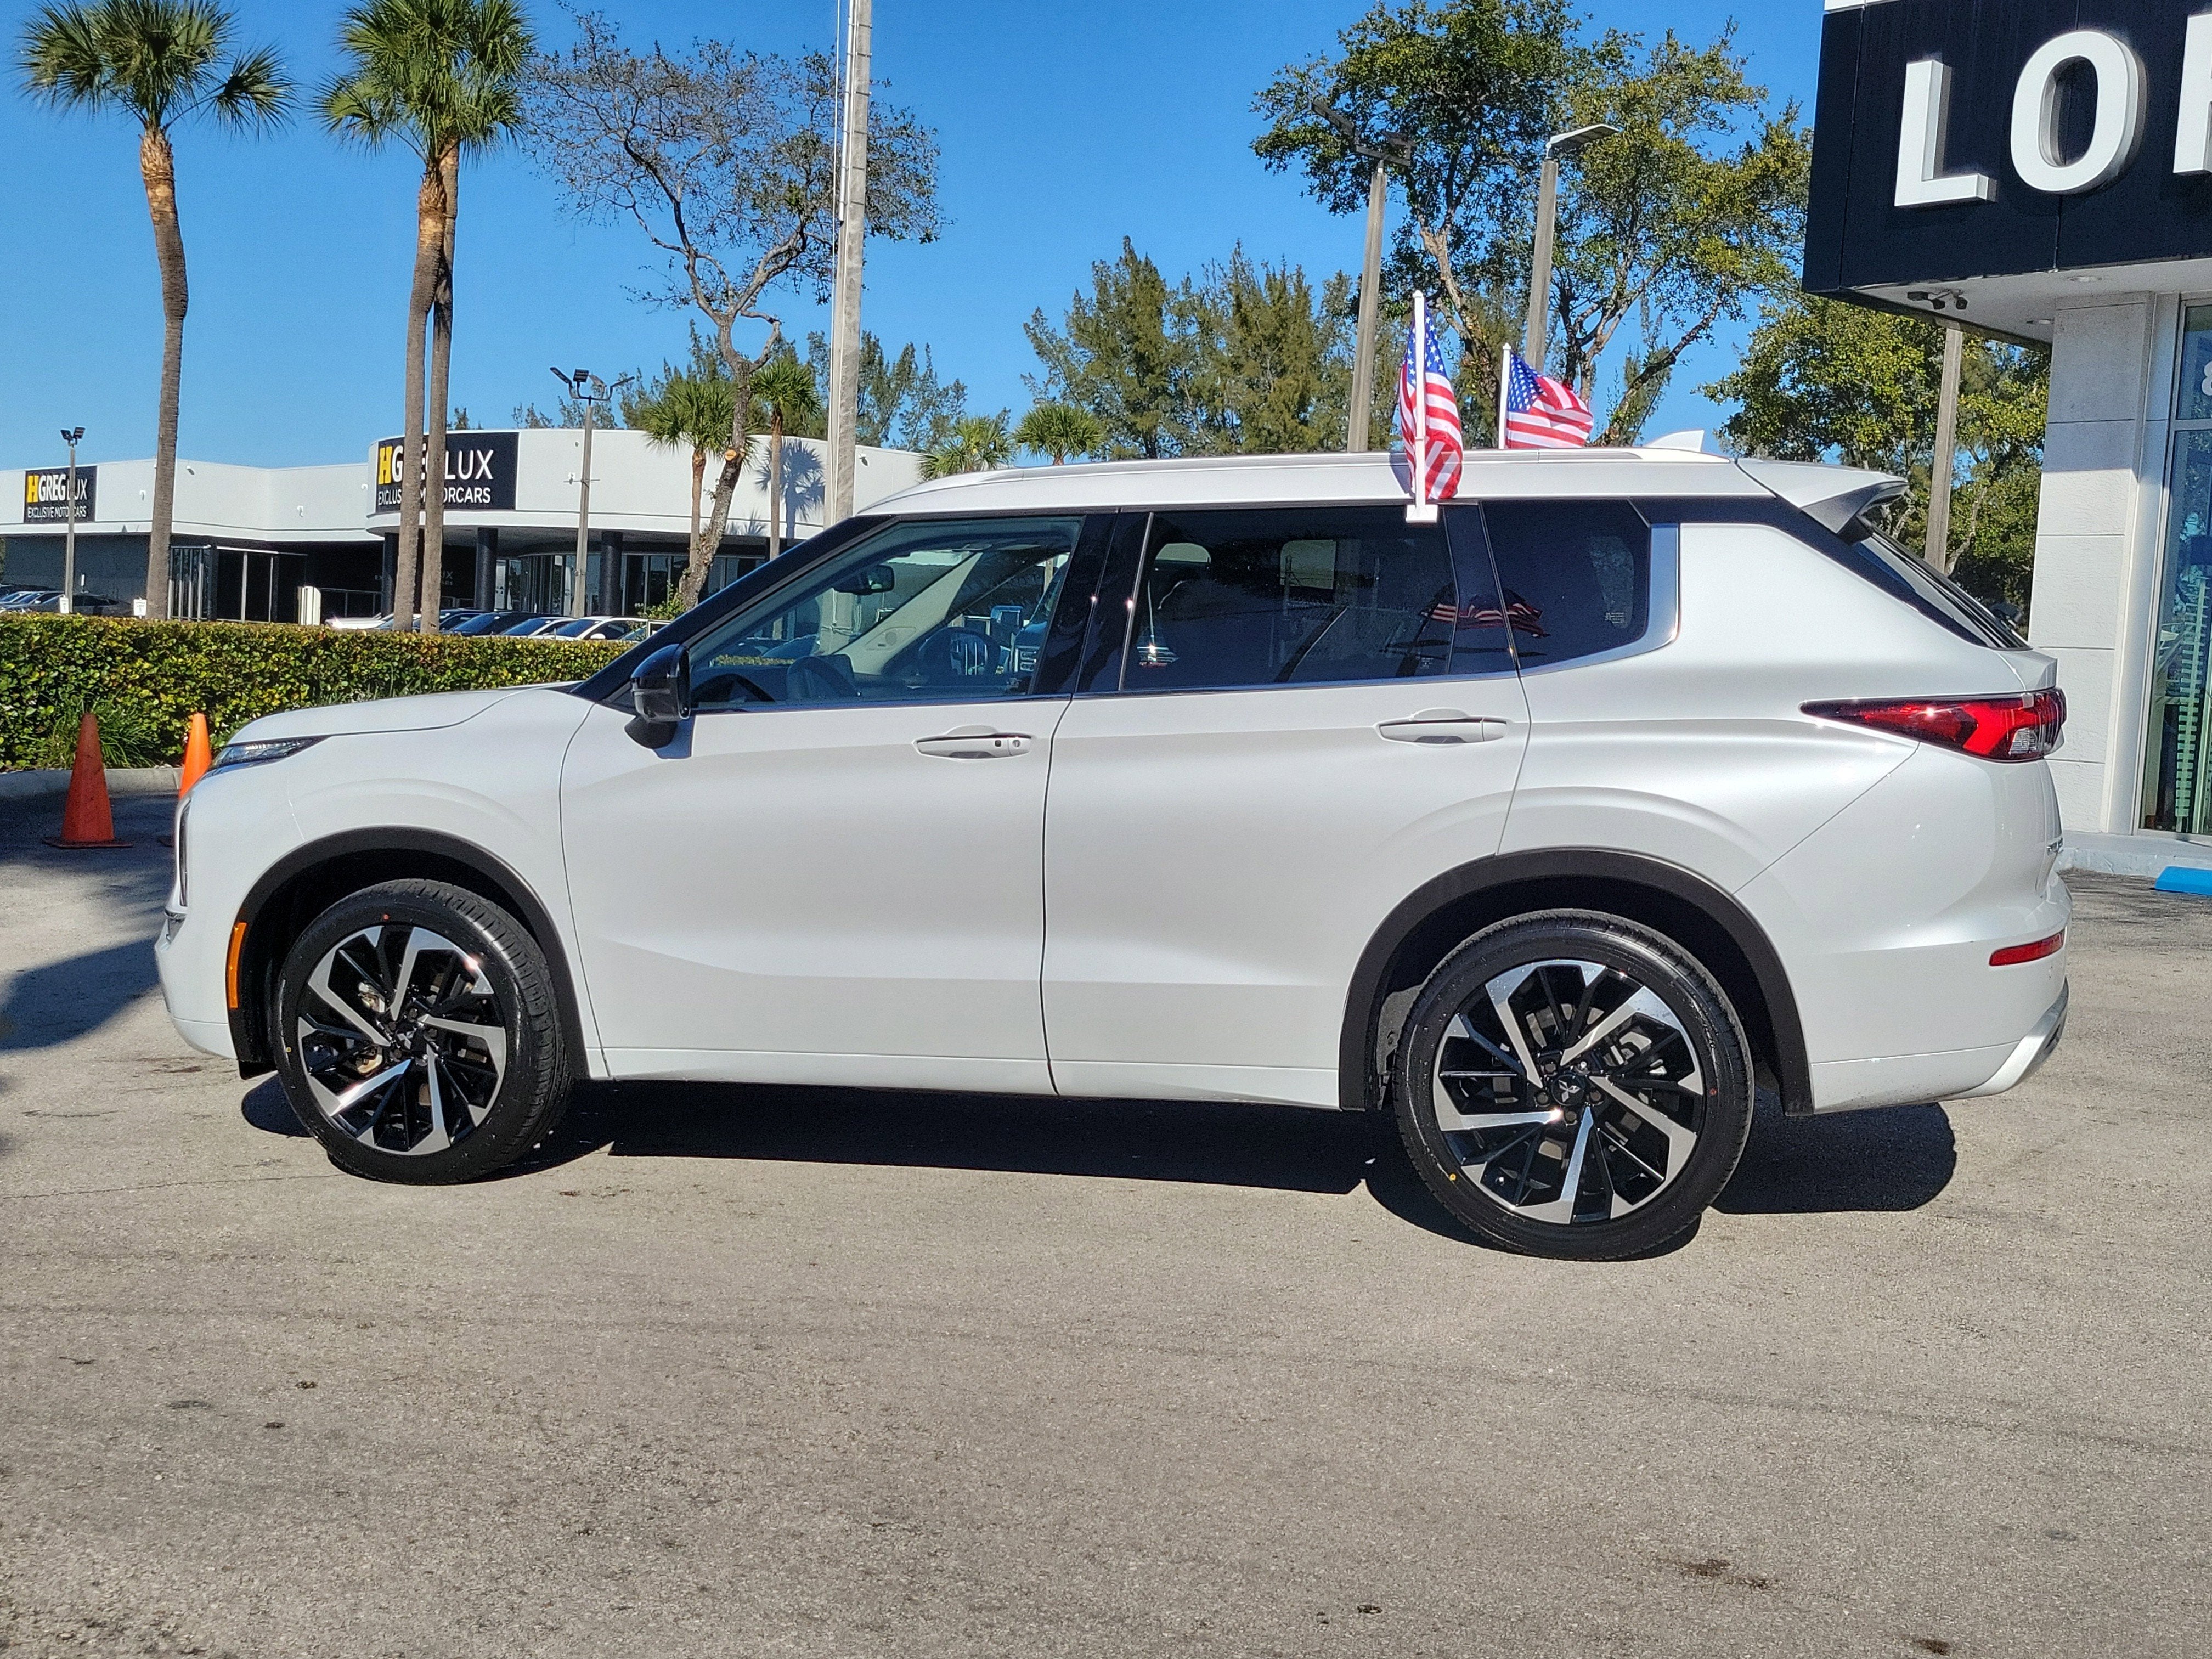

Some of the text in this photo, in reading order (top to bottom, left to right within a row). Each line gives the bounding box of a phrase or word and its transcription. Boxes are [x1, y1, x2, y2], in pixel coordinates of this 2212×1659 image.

[444, 450, 494, 480] LUX
[378, 487, 491, 505] EXCLUS MRCARS
[27, 505, 87, 518] EXCLUSIVE MOTOCARS
